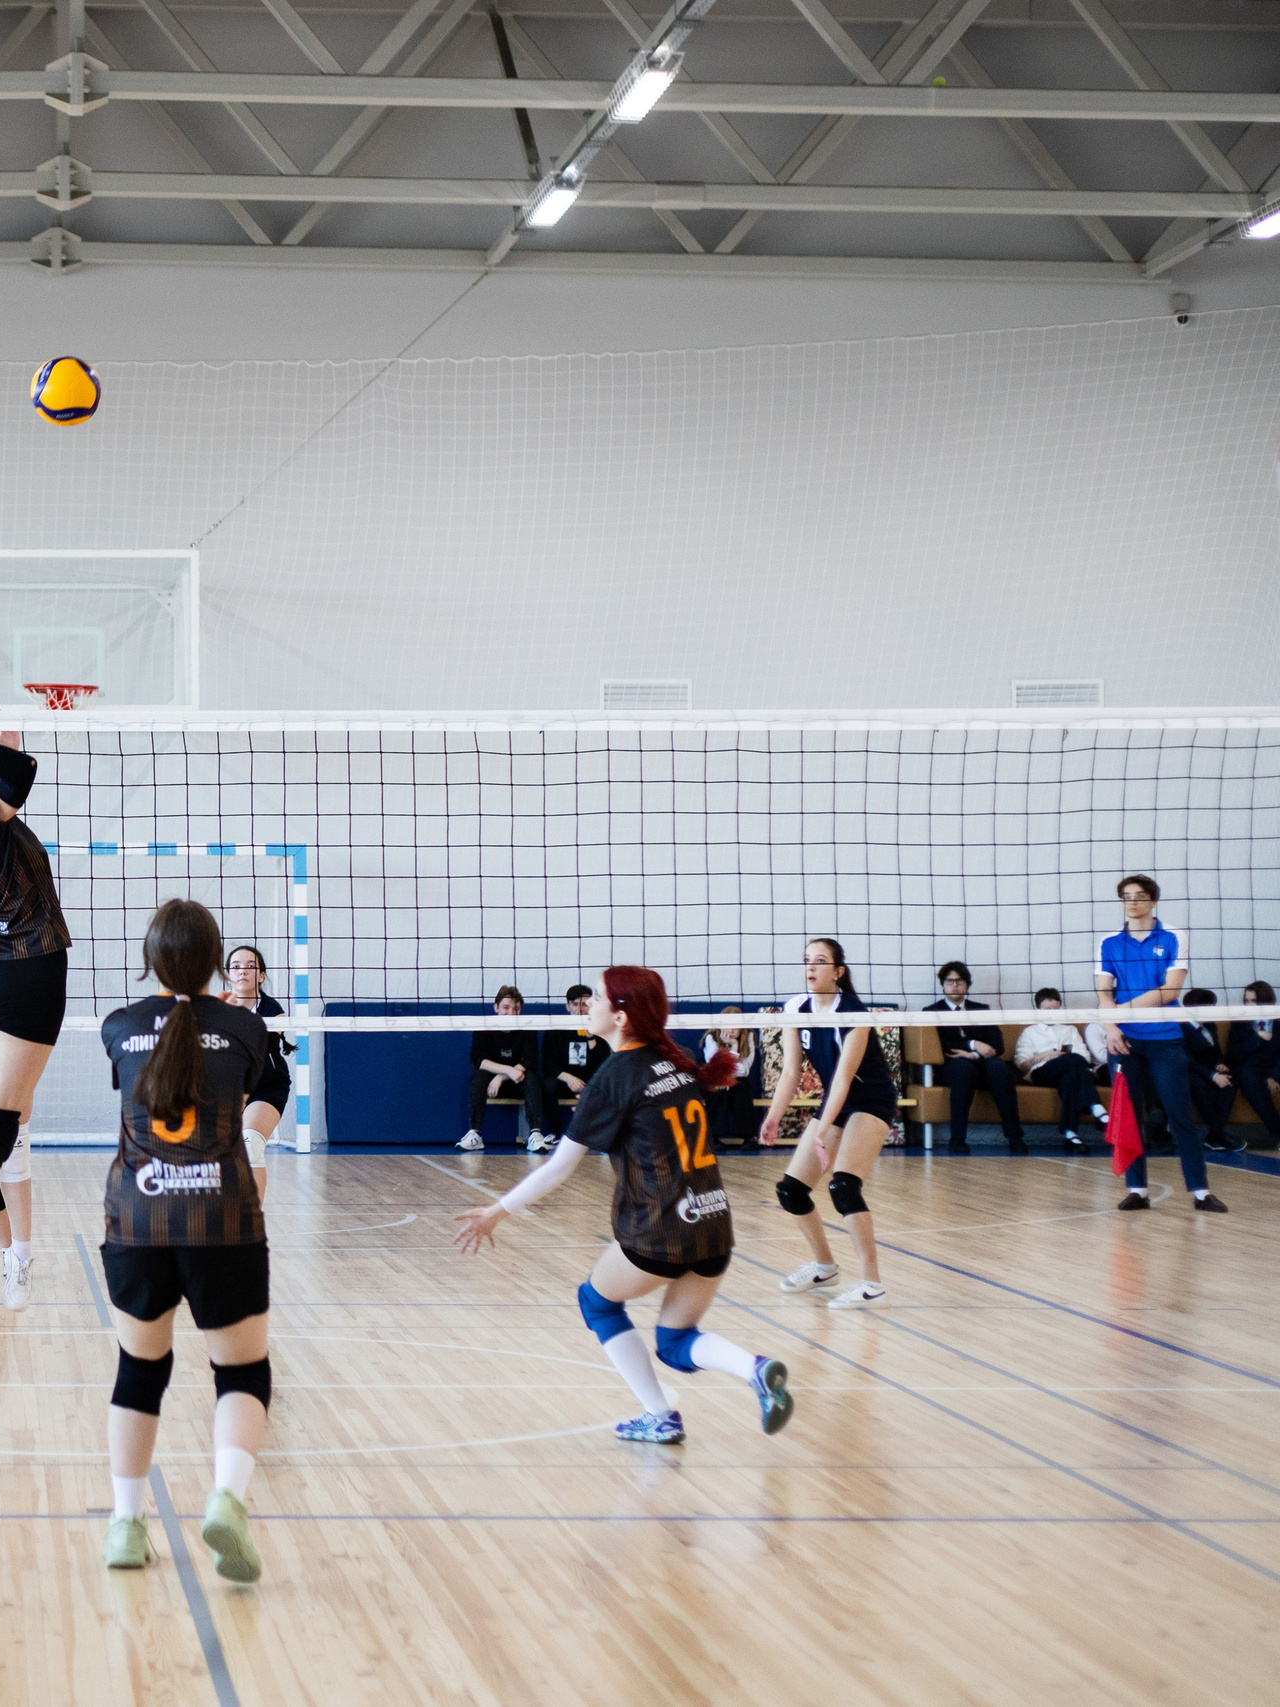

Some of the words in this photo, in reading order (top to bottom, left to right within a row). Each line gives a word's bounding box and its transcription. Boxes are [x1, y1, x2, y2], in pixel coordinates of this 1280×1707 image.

[200, 1033, 230, 1050] 35»
[801, 1029, 811, 1050] 9
[650, 1060, 677, 1076] МБО
[662, 1099, 717, 1173] 12
[163, 1161, 221, 1178] ГАЗПРОМ
